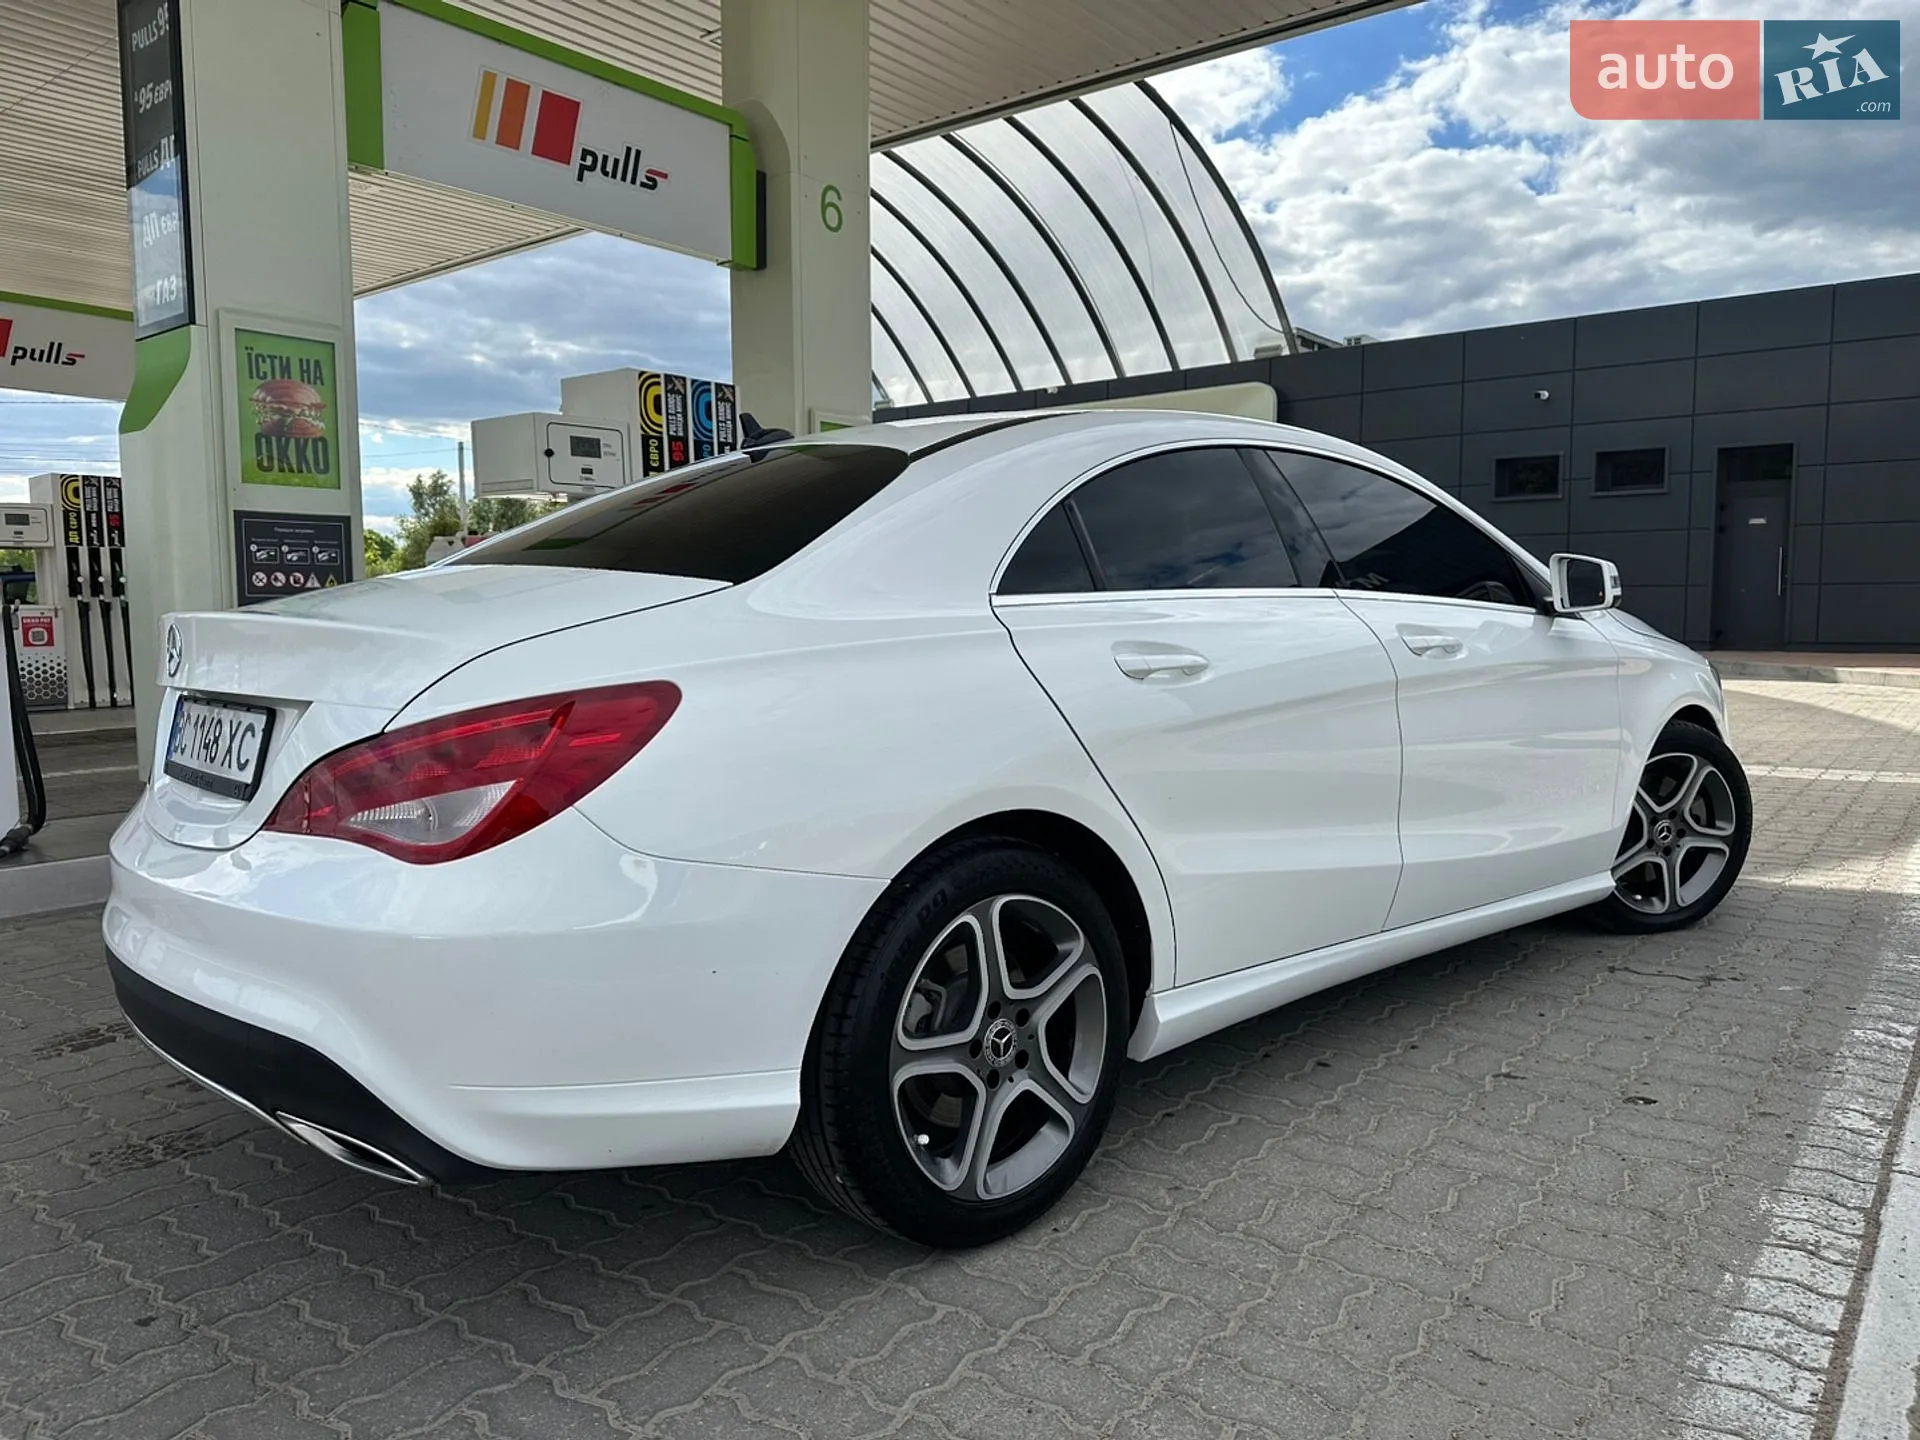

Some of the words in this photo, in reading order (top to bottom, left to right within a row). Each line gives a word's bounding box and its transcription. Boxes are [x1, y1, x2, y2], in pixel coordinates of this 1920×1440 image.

[131, 20, 158, 51] PULLS
[576, 146, 668, 191] pulls
[820, 184, 843, 233] 6
[11, 341, 85, 366] pulls
[245, 345, 292, 380] ЇСТИ
[298, 357, 325, 387] НА
[648, 438, 660, 468] ЄВРО
[190, 713, 223, 764] 1148
[220, 719, 256, 772] XC
